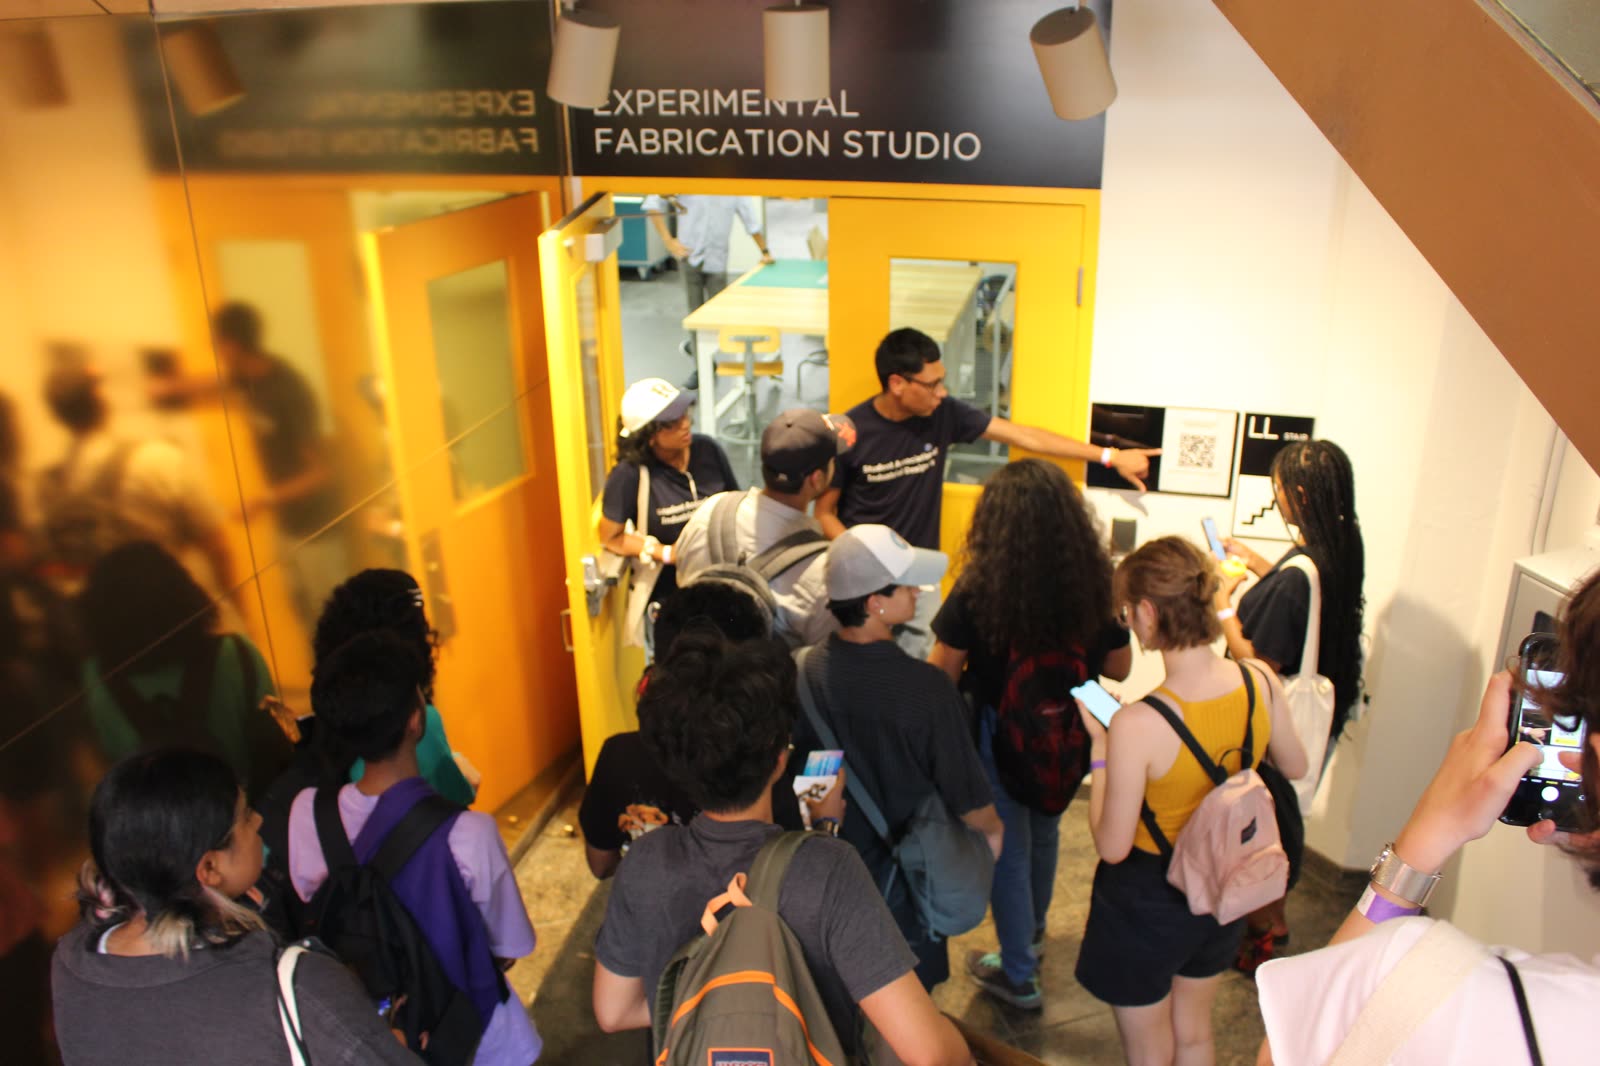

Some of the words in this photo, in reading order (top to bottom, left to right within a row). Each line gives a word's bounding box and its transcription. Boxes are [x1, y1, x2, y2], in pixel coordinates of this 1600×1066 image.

[594, 128, 830, 157] FABRICATION
[843, 129, 982, 161] STUDIO
[1248, 415, 1280, 440] LL
